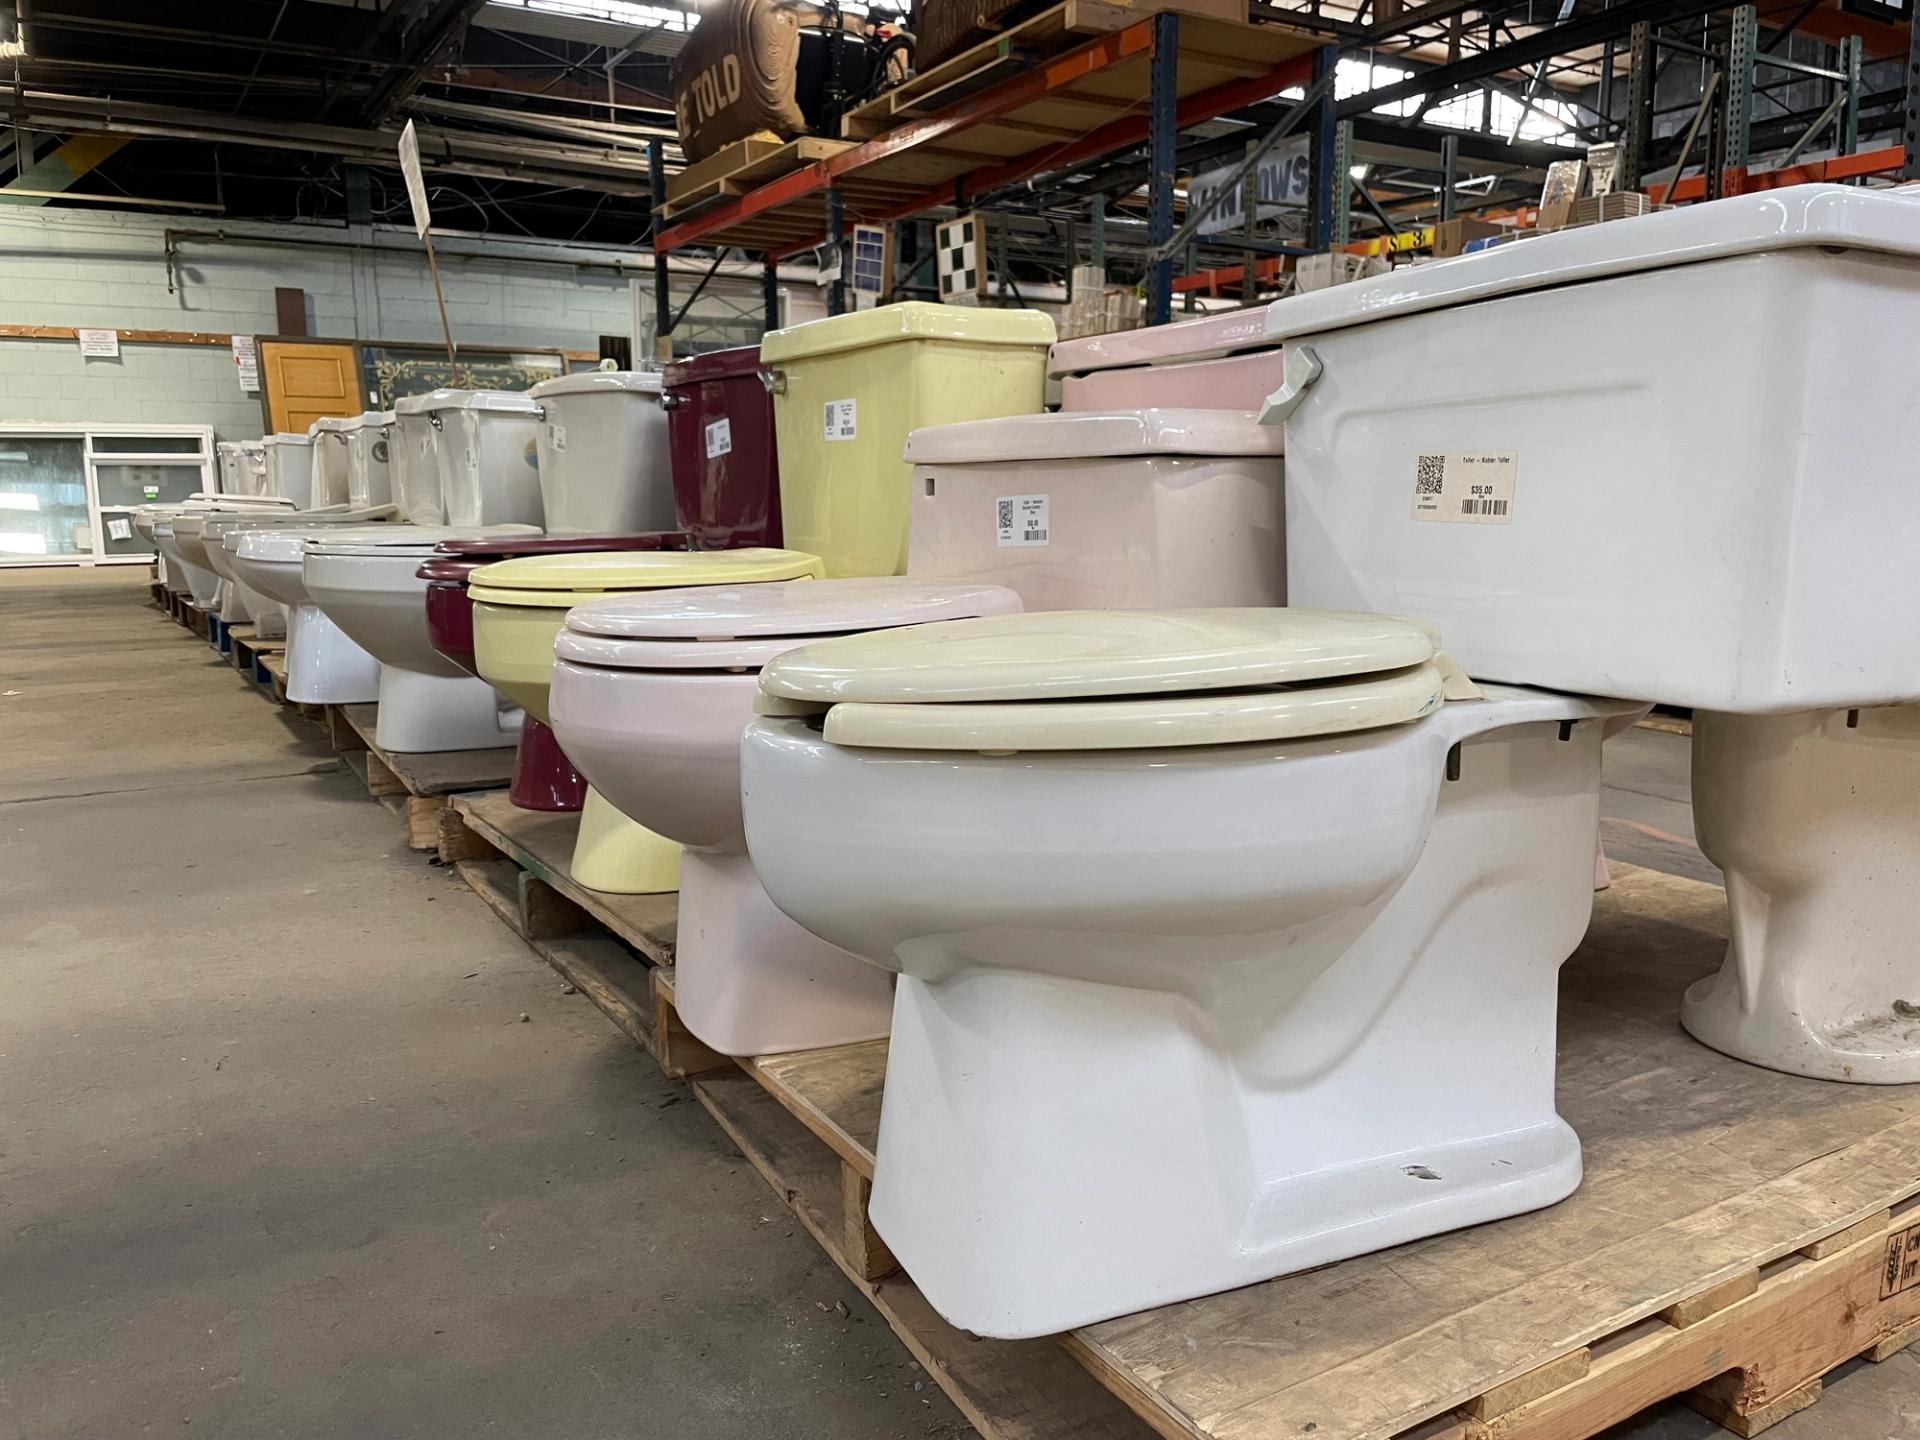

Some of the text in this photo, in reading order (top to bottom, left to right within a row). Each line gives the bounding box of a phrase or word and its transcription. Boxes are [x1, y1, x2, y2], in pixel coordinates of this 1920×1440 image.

[692, 53, 741, 124] TOLD
[1471, 485, 1493, 495] $35.00
[1904, 1260, 1918, 1279] HT
